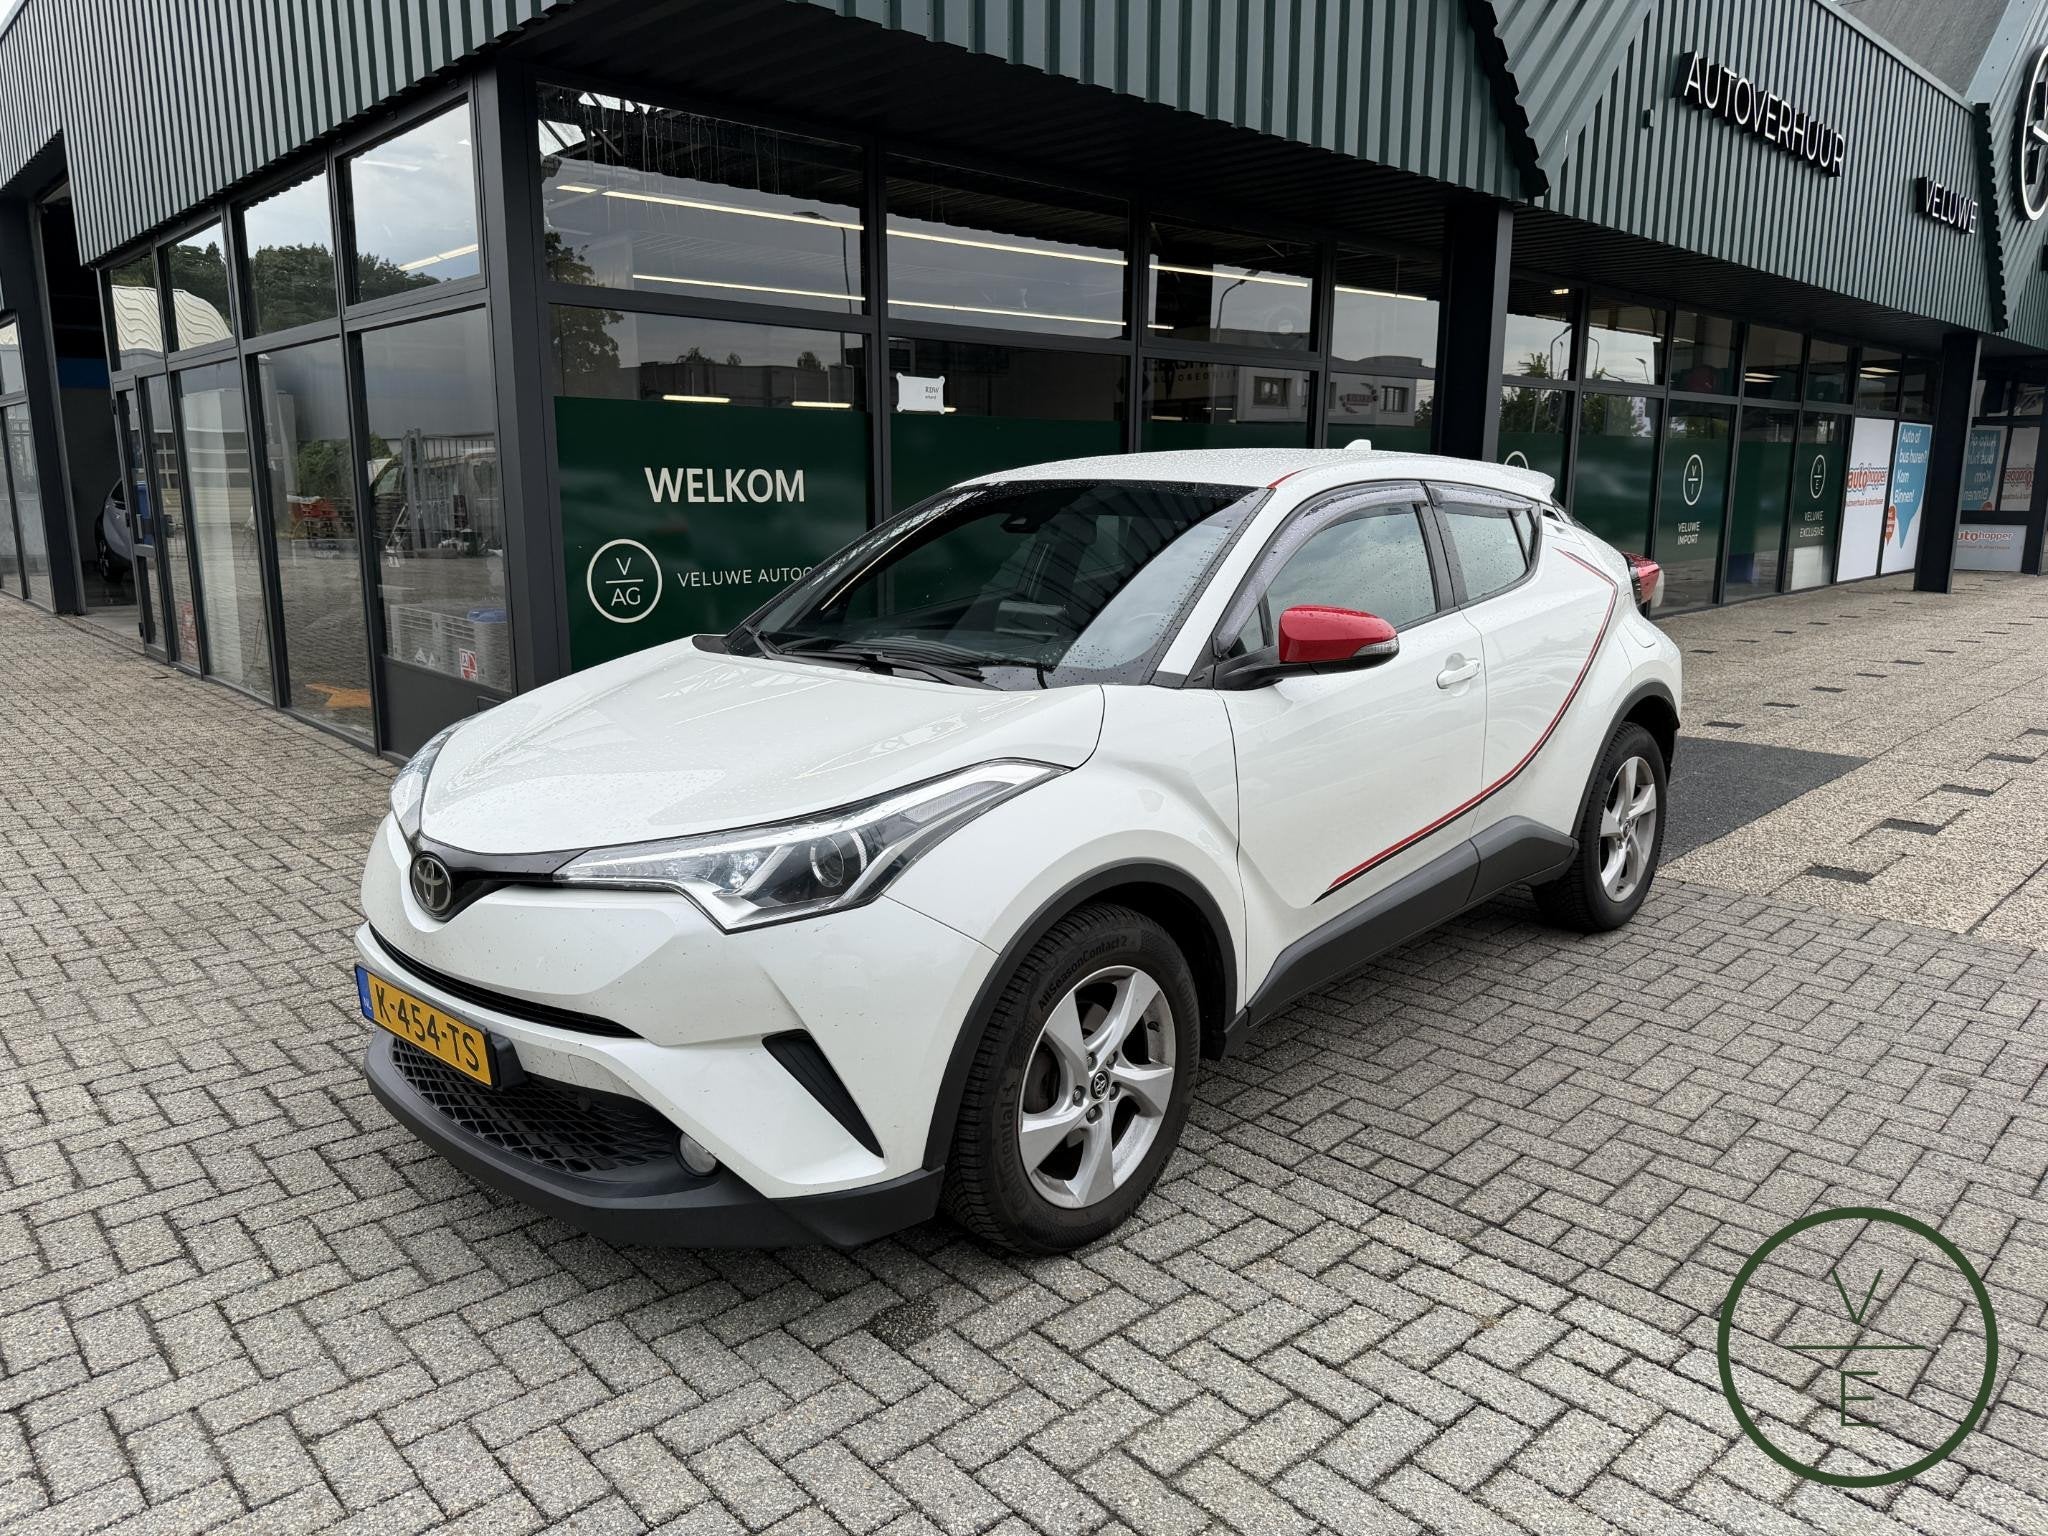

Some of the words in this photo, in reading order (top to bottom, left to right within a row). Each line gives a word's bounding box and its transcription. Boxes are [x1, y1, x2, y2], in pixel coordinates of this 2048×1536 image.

[1683, 50, 1845, 176] AUTOVERHUUR
[1926, 176, 1978, 234] VELUWE
[1902, 429, 1914, 443] Auto
[1899, 449, 1910, 463] bus
[1897, 470, 1910, 483] Kom
[644, 467, 805, 503] WELKOM
[1895, 489, 1915, 503] Binnen!
[1804, 511, 1824, 521] VELUWE
[1678, 521, 1701, 533] VELUWE
[1800, 526, 1825, 538] EXCLUSIVE
[1677, 534, 1699, 545] IMPORT
[616, 557, 631, 576] V
[677, 569, 752, 588] VELUWE
[611, 587, 641, 607] AG
[374, 983, 480, 1072] K-454-TS
